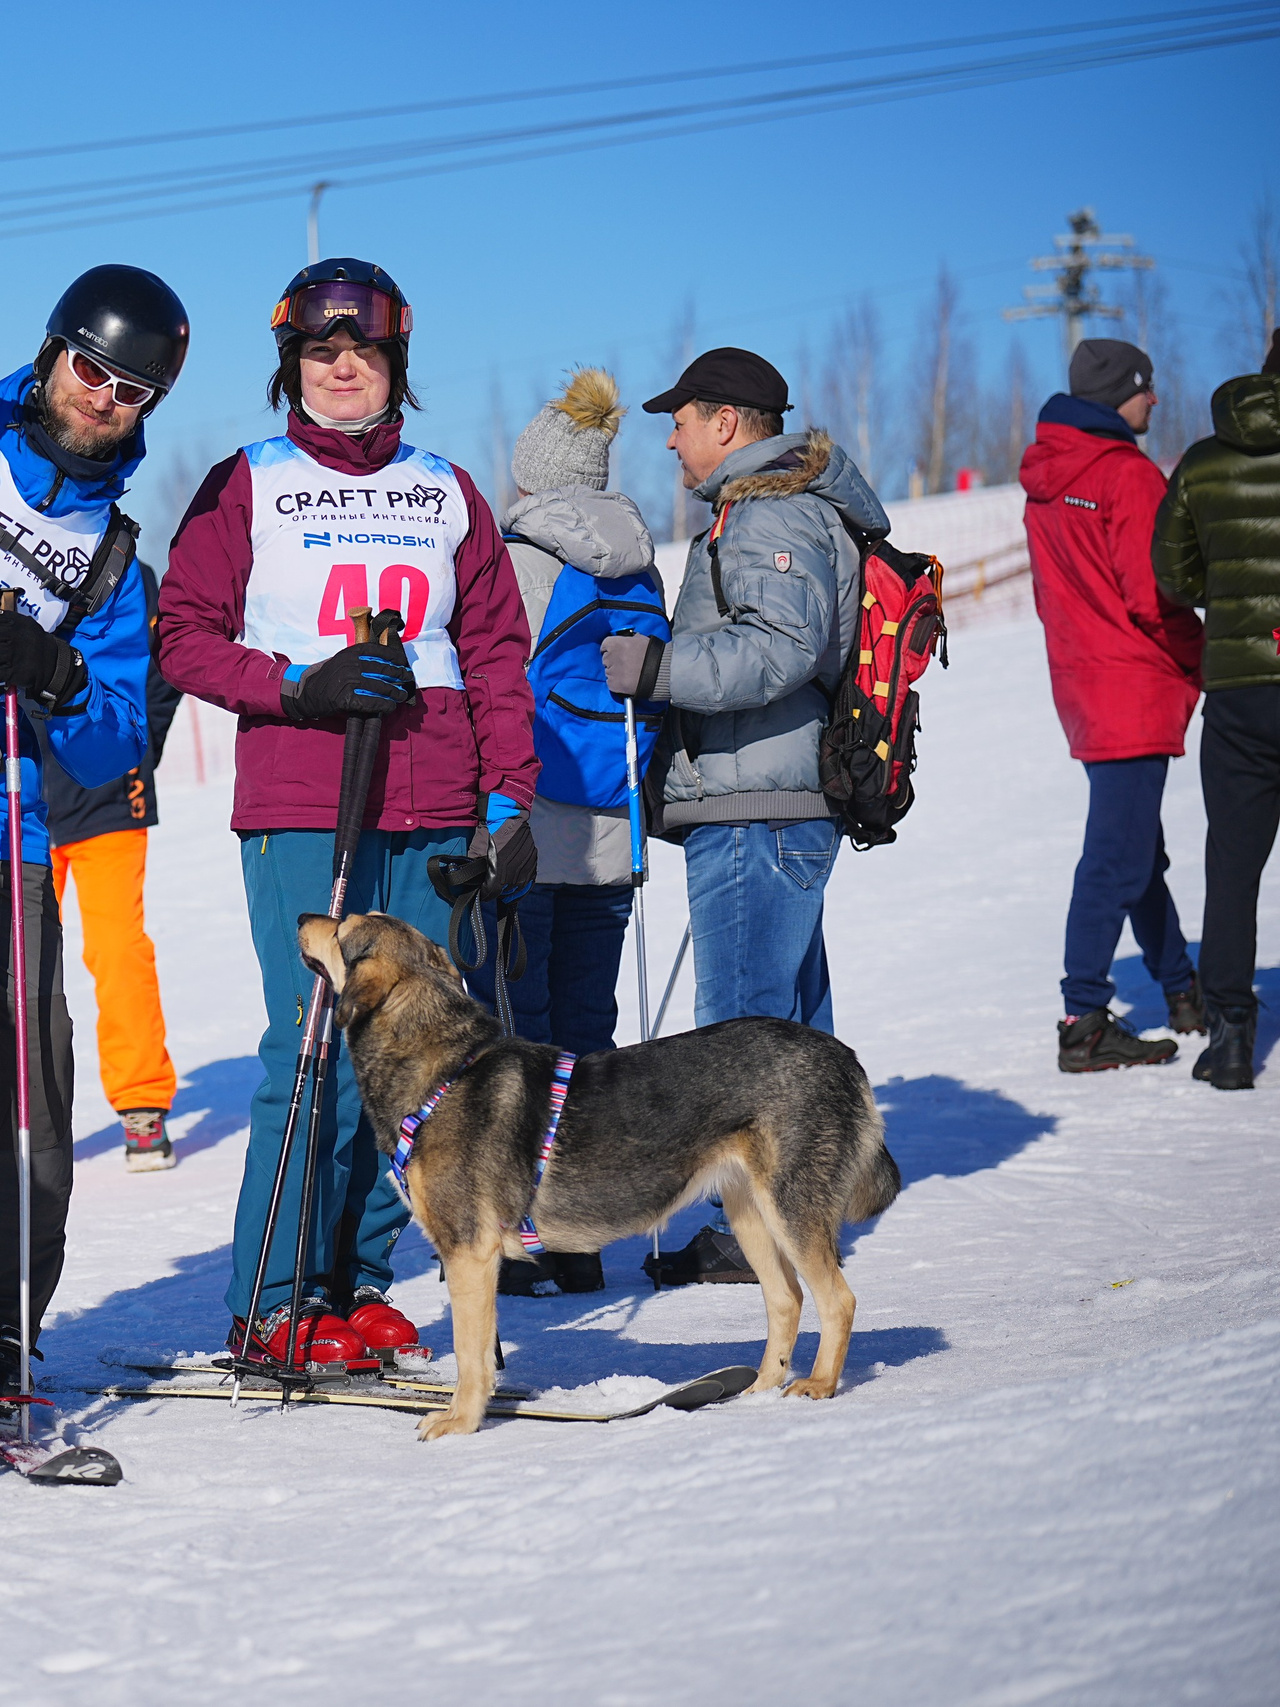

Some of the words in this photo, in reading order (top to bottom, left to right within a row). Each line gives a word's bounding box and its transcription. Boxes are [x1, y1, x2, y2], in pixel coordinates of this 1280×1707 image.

[275, 489, 377, 515] CRAFT
[386, 490, 443, 515] PRO
[280, 513, 366, 524] ОРТИВНЫЕ
[337, 533, 436, 549] NORDSKI
[4, 553, 46, 586] ИНТЕН
[32, 539, 81, 585] PRO
[317, 564, 430, 647] 40
[300, 1339, 338, 1350] SCARPA
[56, 1462, 106, 1479] K2
